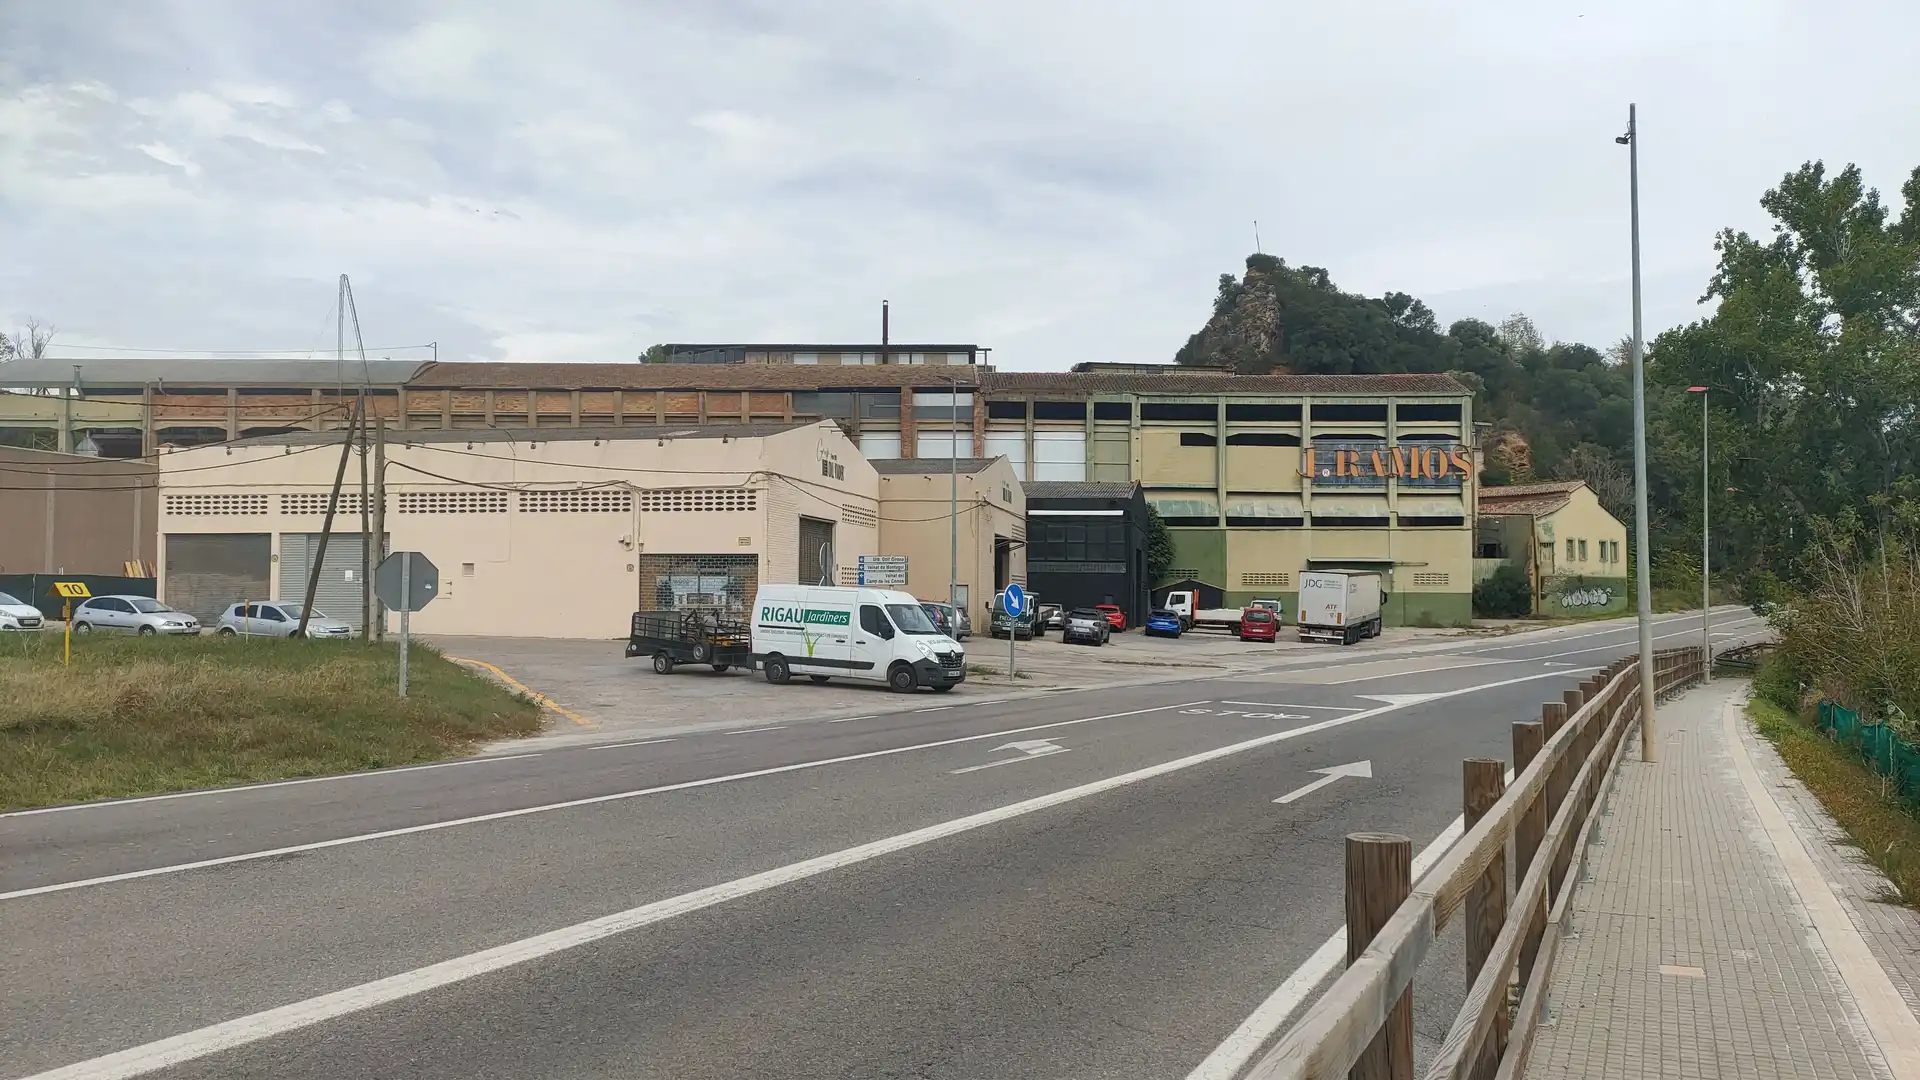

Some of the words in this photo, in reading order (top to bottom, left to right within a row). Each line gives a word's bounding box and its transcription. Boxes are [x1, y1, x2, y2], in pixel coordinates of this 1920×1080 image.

[63, 584, 83, 595] 10
[1304, 579, 1322, 589] JDG
[761, 606, 804, 624] RIGAU
